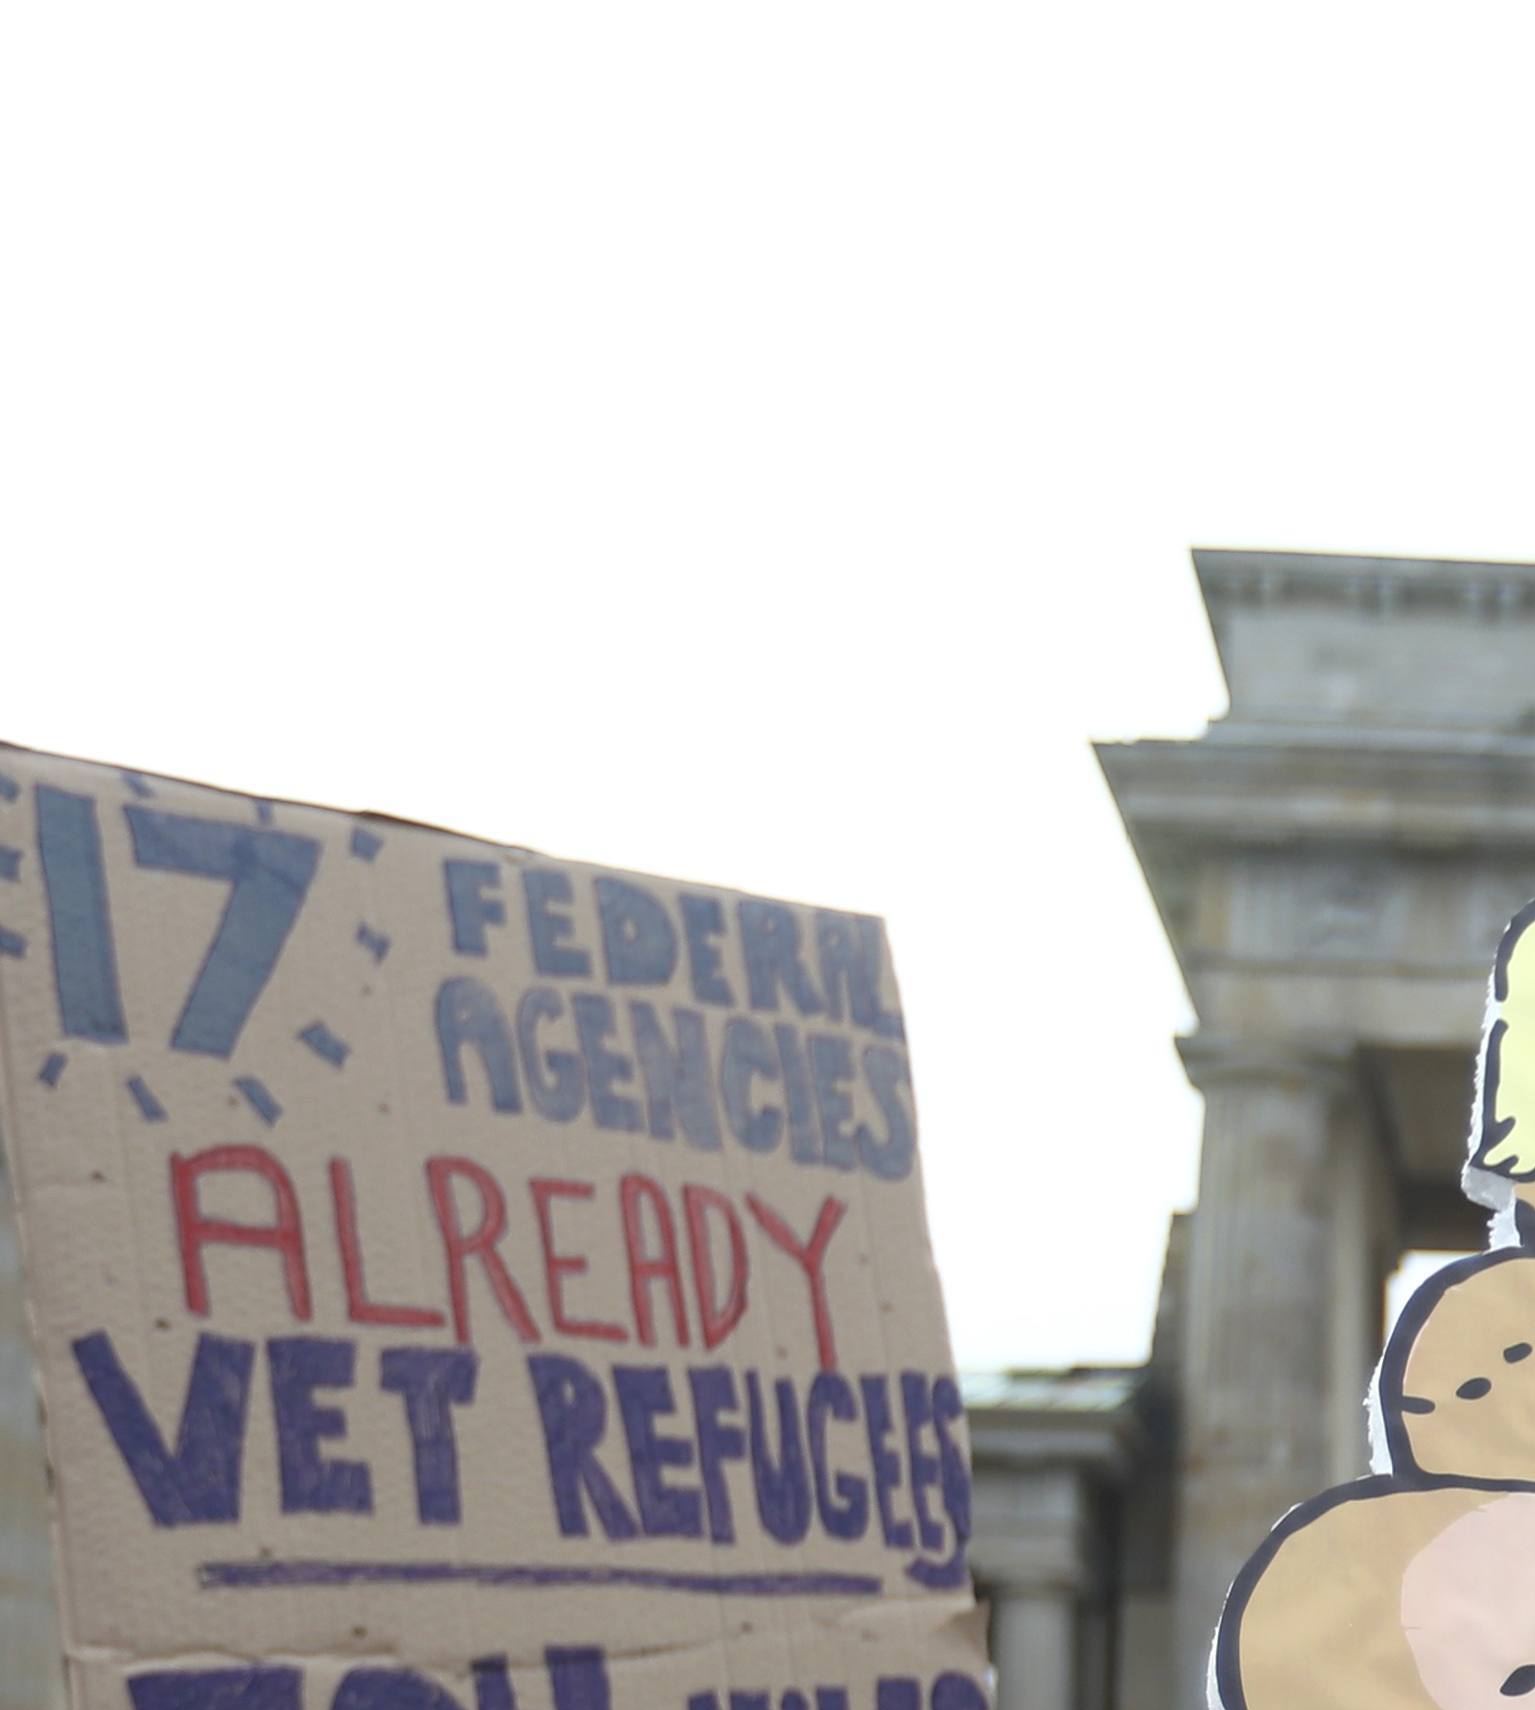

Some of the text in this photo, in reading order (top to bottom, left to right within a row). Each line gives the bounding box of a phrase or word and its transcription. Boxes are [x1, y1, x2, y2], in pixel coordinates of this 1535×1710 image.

[441, 857, 907, 1041] FEDERAL
[433, 974, 918, 1183] AGENCIES
[168, 1142, 847, 1370] ALREADY
[71, 1330, 974, 1592] VET REFUGEES
